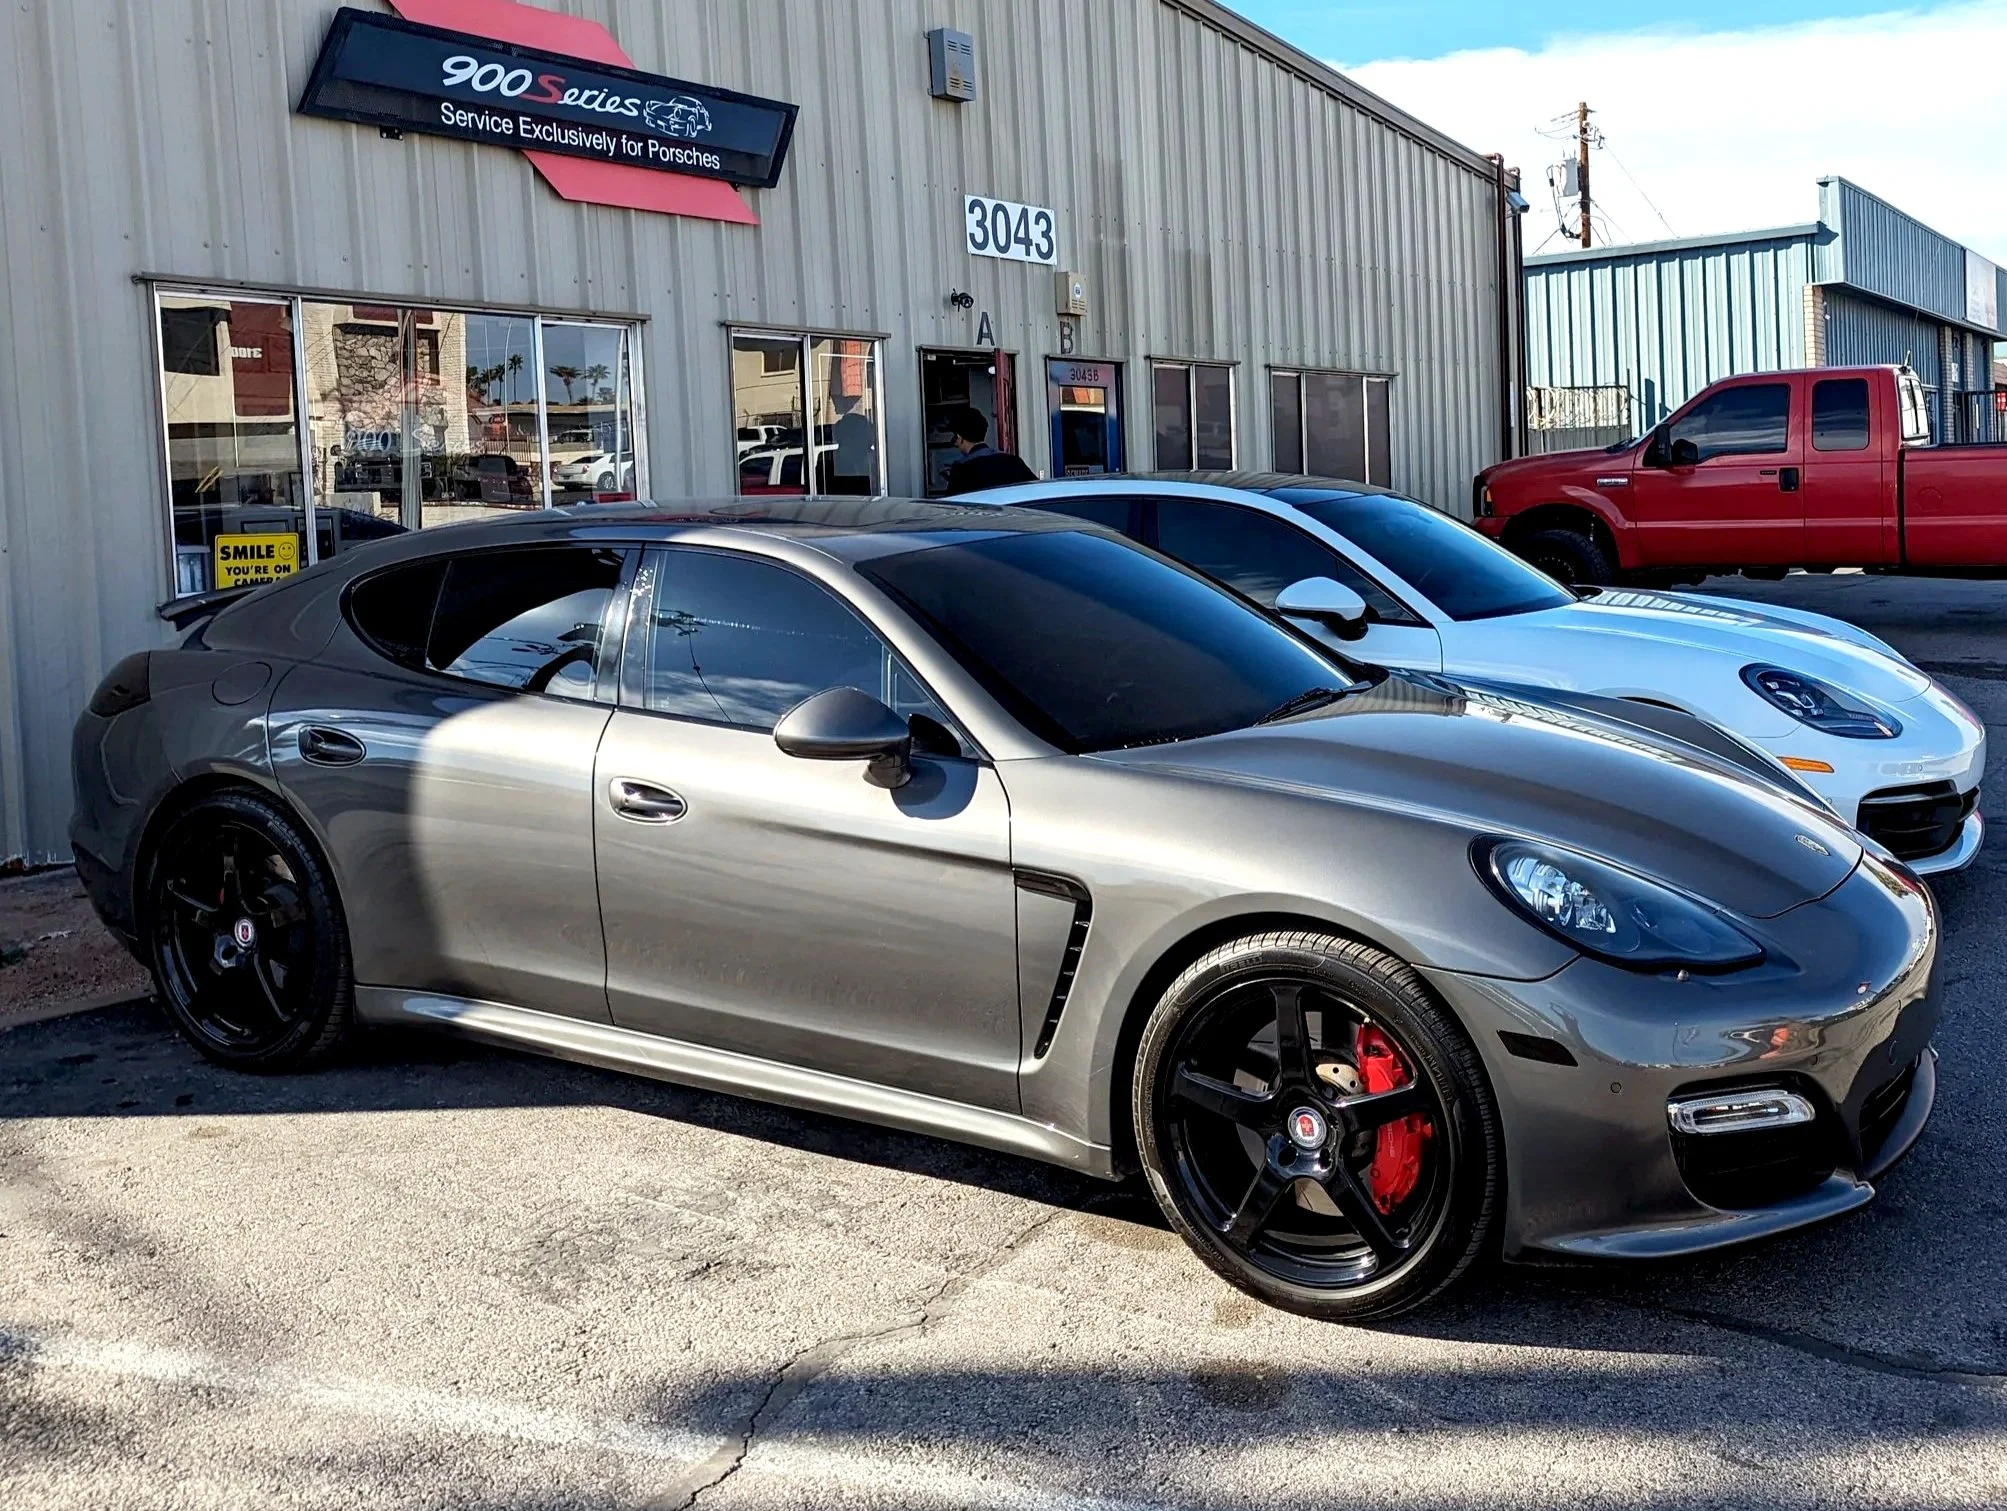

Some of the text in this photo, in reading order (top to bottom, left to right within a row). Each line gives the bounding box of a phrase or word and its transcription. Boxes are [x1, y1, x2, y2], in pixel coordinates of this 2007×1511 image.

[440, 102, 721, 170] Service Exclusively for Porsches
[968, 198, 1054, 261] 3043
[976, 311, 995, 346] A
[1060, 321, 1074, 354] B
[220, 545, 275, 561] SMILE
[225, 564, 291, 576] YOU'RE ON
